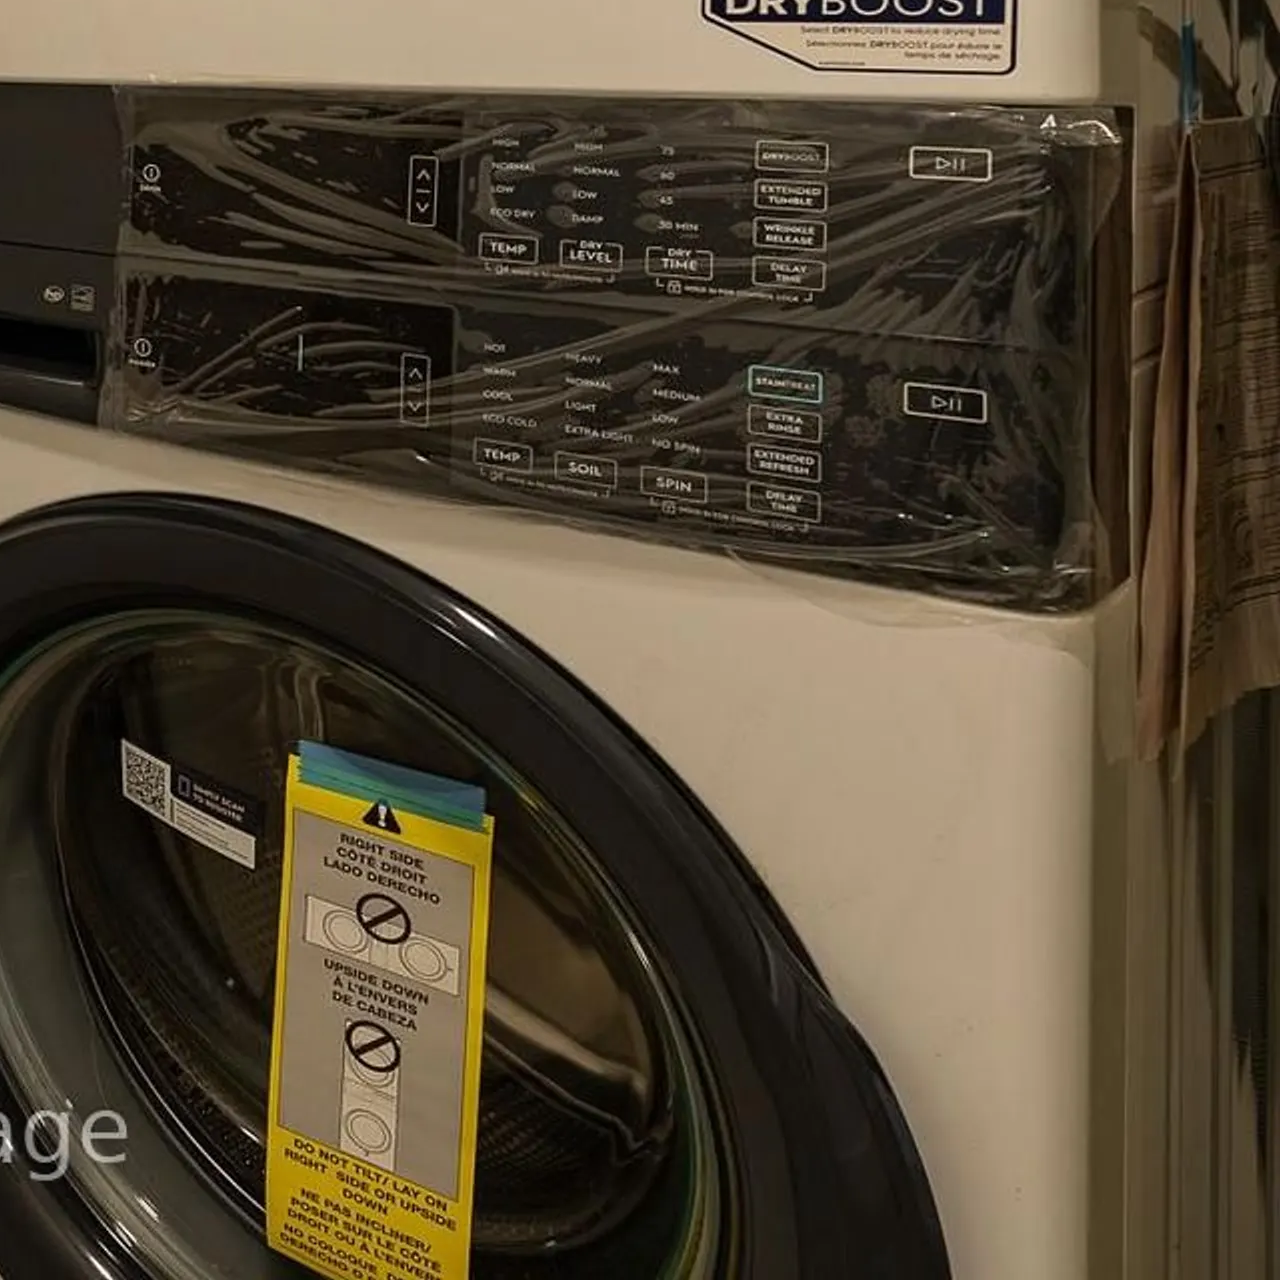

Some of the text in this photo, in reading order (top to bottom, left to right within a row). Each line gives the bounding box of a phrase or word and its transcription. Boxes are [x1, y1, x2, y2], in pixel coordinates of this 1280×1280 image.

[573, 166, 621, 177] NORMAL
[572, 190, 597, 199] LOW
[760, 185, 822, 195] EXTENDED
[769, 196, 814, 206] TUMBLE
[514, 209, 536, 218] DRY
[763, 224, 816, 235] WRINKLE
[580, 240, 604, 249] DRY
[766, 235, 814, 245] RELEASE
[490, 242, 527, 255] TEMP
[667, 248, 691, 257] DRY
[569, 249, 613, 263] LEVEL
[661, 258, 699, 271] TIME
[770, 263, 807, 273] DELAY
[484, 343, 506, 353] HOT
[653, 364, 680, 375] MAX
[652, 388, 701, 402] MEDIUM
[565, 400, 597, 412] LIGHT
[507, 416, 537, 428] COLD
[766, 411, 803, 424] EXTRA
[565, 424, 634, 443] EXTRA LIGHT
[768, 423, 802, 434] RINSE
[652, 438, 671, 449] NO
[483, 448, 521, 462] TEMP
[754, 449, 816, 466] EXTENDED
[568, 462, 603, 477] SOIL
[759, 461, 810, 476] REFRESH
[656, 476, 692, 492] SPIN
[766, 490, 804, 503] DELAY
[340, 832, 425, 870] RIGHT SIDE
[381, 860, 428, 884] DROIT
[323, 856, 441, 905] LADO DERECHO
[324, 958, 430, 1005] UPSIDE DOWN
[347, 982, 418, 1016] L'ENVERS
[332, 990, 418, 1031] DE CABEZA
[293, 1138, 448, 1212] DO NOT TILT/ LAY ON
[284, 1148, 457, 1231] RIGHT SIDE OR UPSIDE
[343, 1188, 389, 1216] DOWN
[291, 1197, 341, 1224] POSER
[345, 1219, 371, 1242] SUR
[376, 1232, 395, 1249] LE
[301, 1188, 431, 1253] NE PAS INCLINER/
[284, 1222, 378, 1275] NO COLOQUE
[288, 1208, 331, 1233] DROIT
[335, 1230, 356, 1246] OU
[374, 1246, 443, 1280] L'ENVER
[280, 1231, 352, 1273] DERECHO
